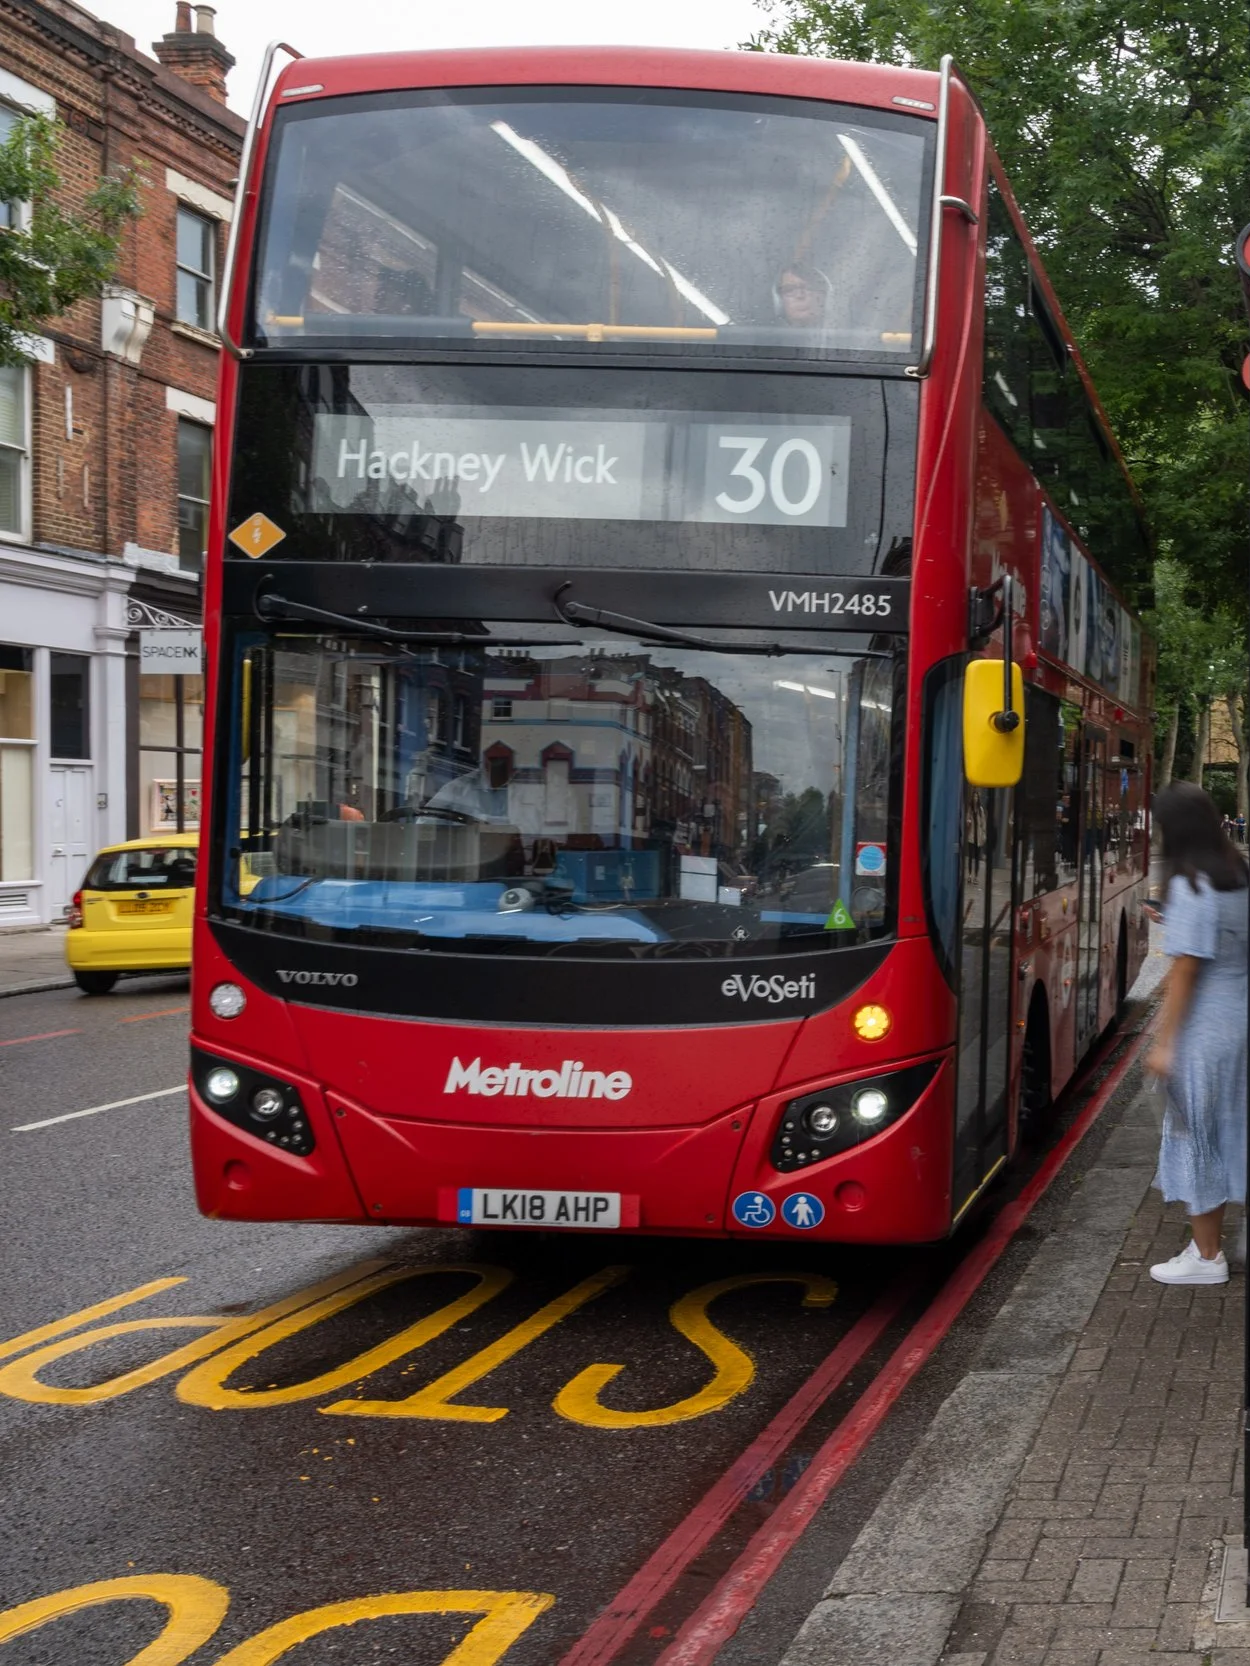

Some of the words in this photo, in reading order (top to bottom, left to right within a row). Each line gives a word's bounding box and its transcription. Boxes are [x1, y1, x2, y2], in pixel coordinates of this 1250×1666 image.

[336, 439, 505, 492] Hackney
[521, 443, 618, 485] Wick
[714, 435, 824, 517] 30
[769, 590, 893, 618] VMH2485
[833, 910, 846, 925] 6
[276, 969, 359, 988] VOLVO
[720, 973, 816, 1003] eVoSeti
[445, 1057, 632, 1101] Metroline
[482, 1192, 546, 1222] LK18
[554, 1195, 610, 1223] AHP
